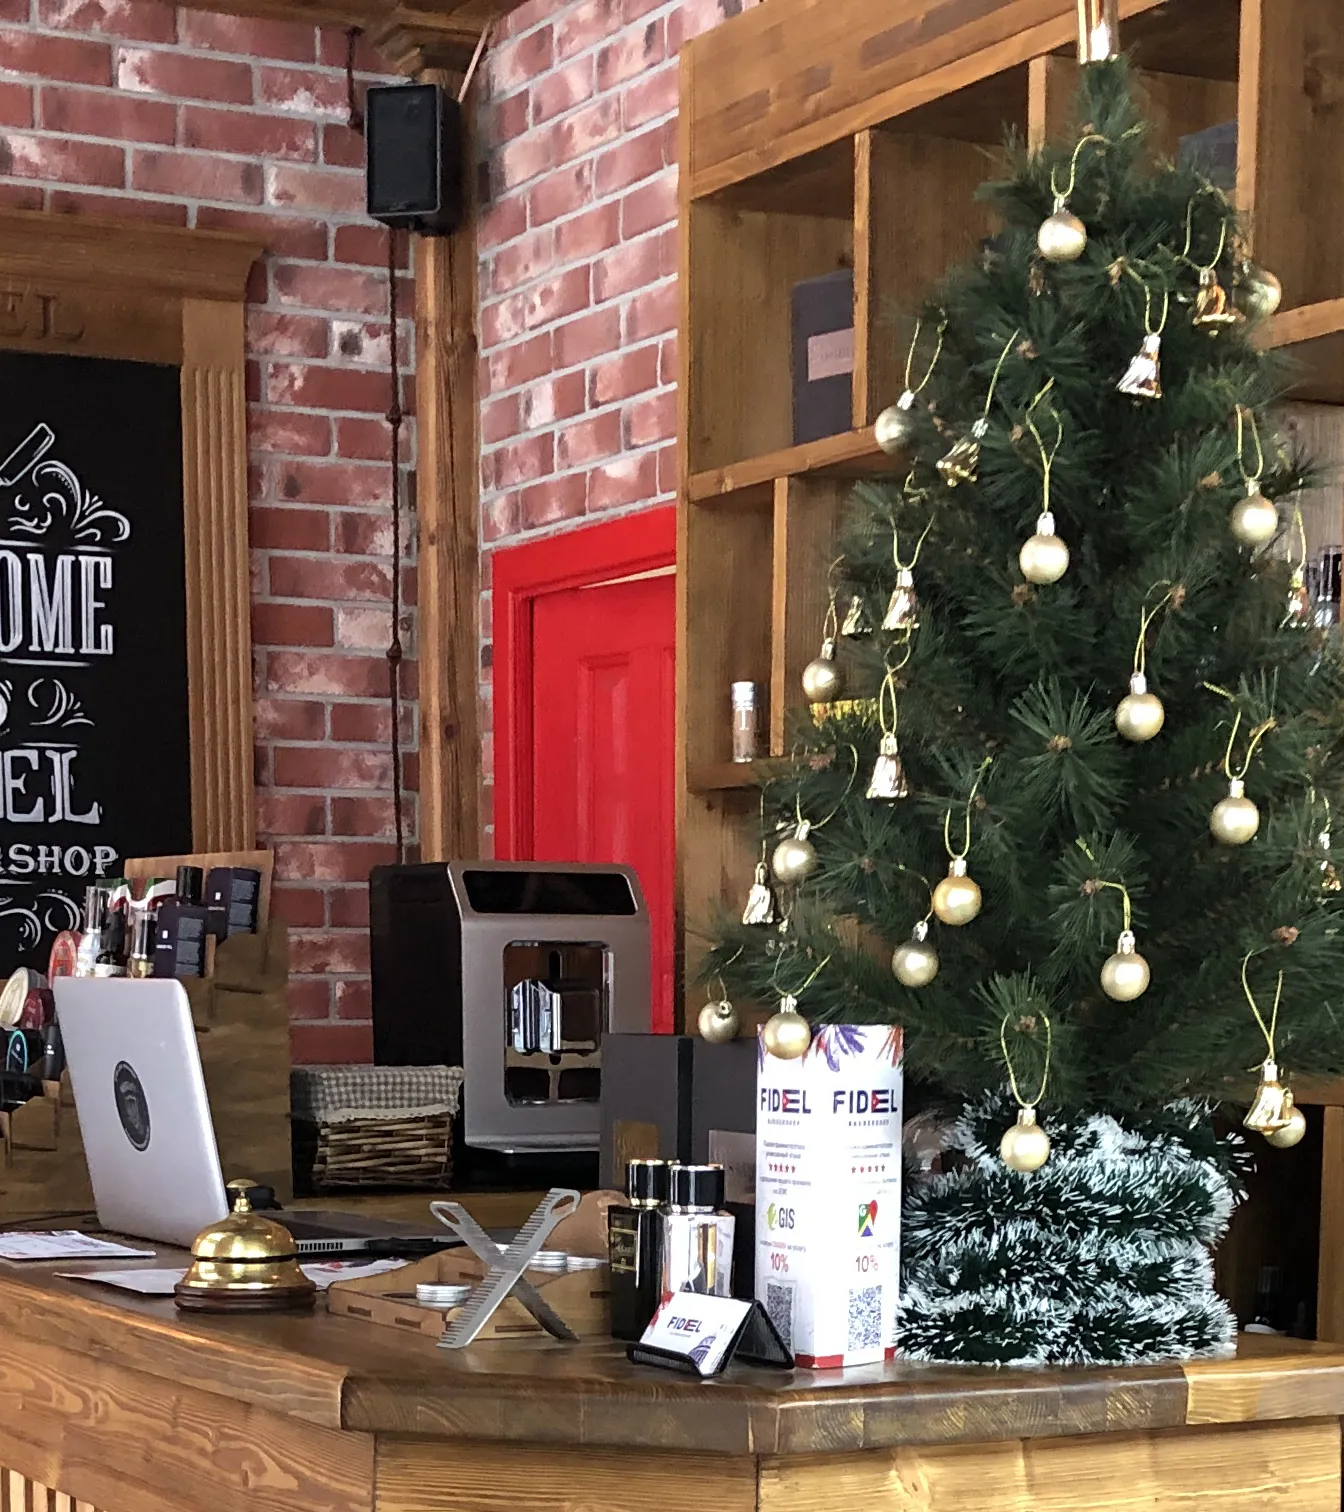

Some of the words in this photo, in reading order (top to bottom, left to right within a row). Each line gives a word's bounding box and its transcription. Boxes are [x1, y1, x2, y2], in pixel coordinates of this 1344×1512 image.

[760, 1087, 812, 1115] FIDEL
[832, 1089, 898, 1115] FIDEL
[770, 1252, 790, 1273] 10%
[667, 1316, 703, 1333] FIDEL
